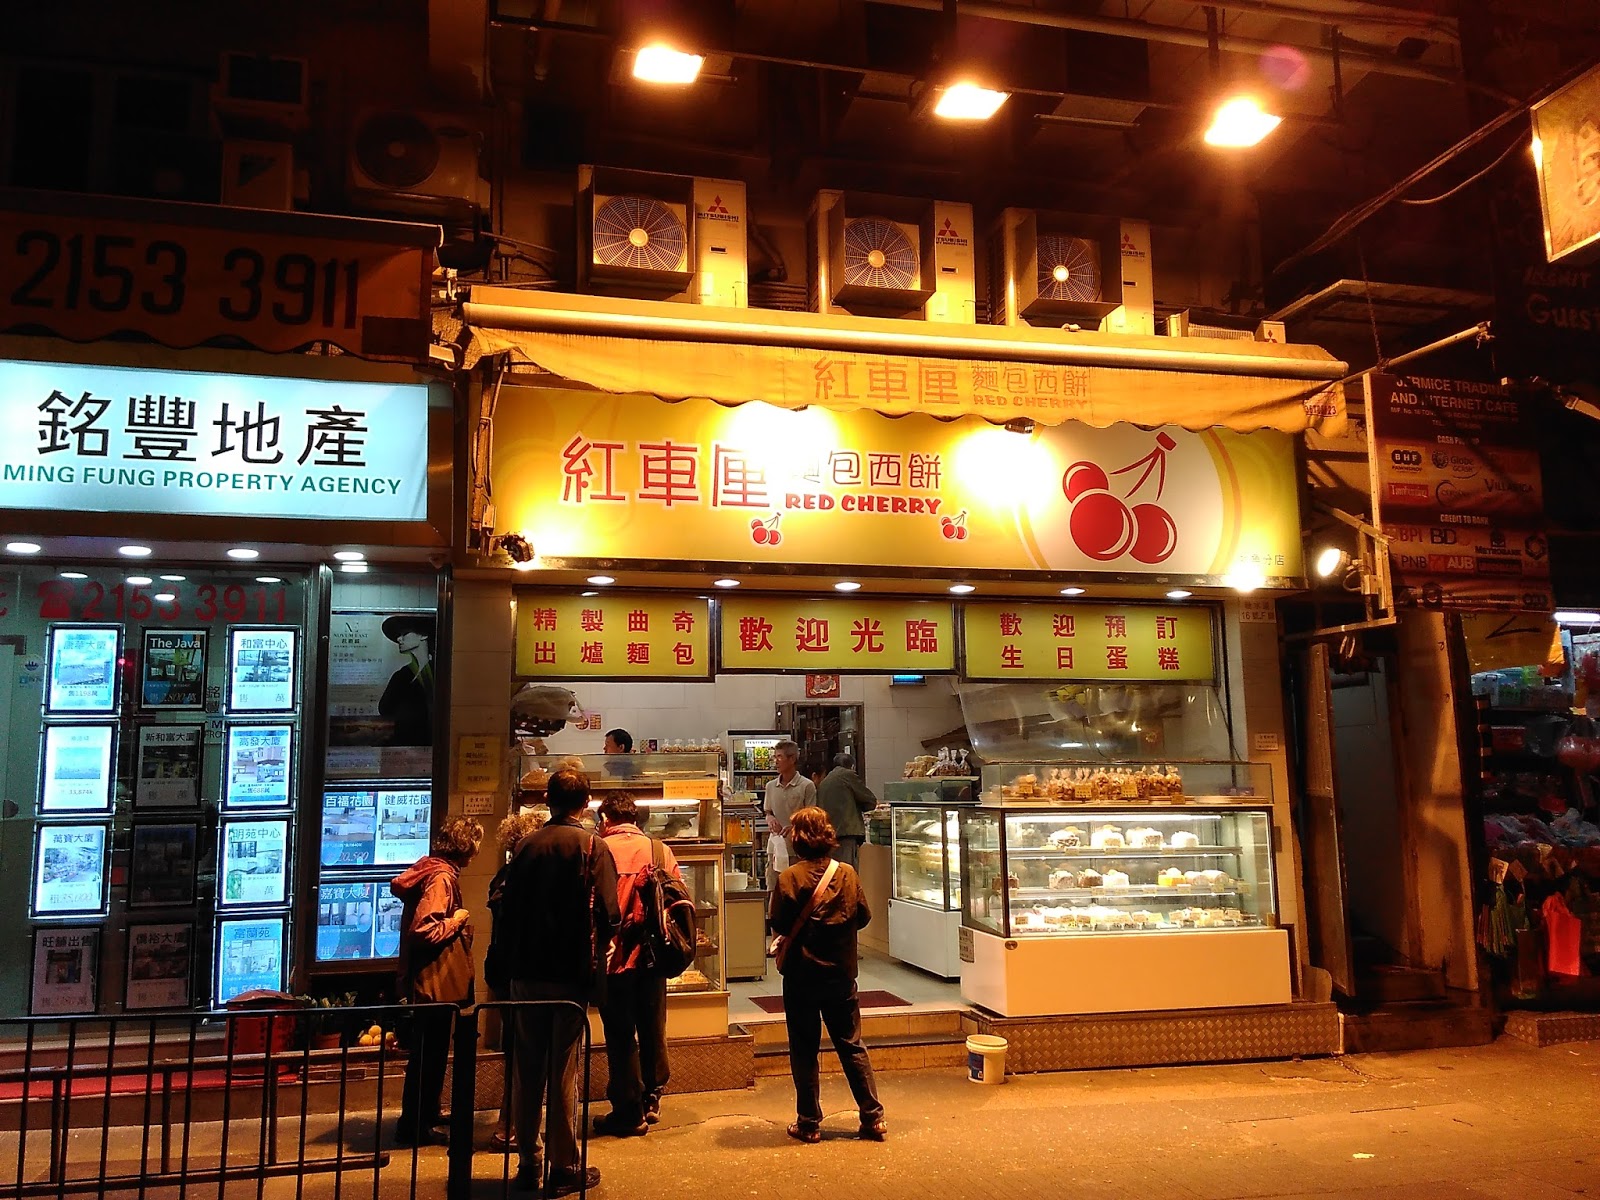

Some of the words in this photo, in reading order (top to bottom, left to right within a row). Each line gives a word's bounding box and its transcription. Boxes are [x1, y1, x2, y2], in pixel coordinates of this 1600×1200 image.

[11, 230, 187, 314] 2153
[219, 248, 358, 329] 3911
[814, 355, 961, 404] 紅車厘
[971, 364, 1089, 396] 麵包西餅
[973, 394, 1007, 406] RED
[1012, 395, 1088, 409] CHERRY
[1390, 391, 1418, 405] AND
[1421, 395, 1482, 411] ITERNET
[37, 389, 368, 468] 銘豐地產
[4, 464, 75, 484] MING
[83, 468, 155, 487] FUNG
[163, 471, 294, 491] PROPERTY
[300, 475, 402, 495] AGENCY
[562, 434, 770, 508] 紅車厘
[785, 492, 835, 510] RED
[840, 494, 942, 515] CHERRY
[1401, 555, 1427, 569] PNB
[1447, 556, 1474, 569] AUB
[81, 583, 182, 621] 2153
[195, 584, 287, 623] 3911
[532, 607, 695, 634] 精製曲奇
[1000, 612, 1178, 640] 歡迎預訂
[150, 638, 173, 649] The
[175, 638, 201, 649] Java
[240, 638, 288, 649] 和富中心
[739, 616, 939, 654] 歡迎光臨
[533, 641, 696, 666] 出爐麵包
[1001, 644, 1181, 671] 生日蛋糕
[325, 795, 374, 807] 百福花園
[384, 794, 432, 806] 健威花園
